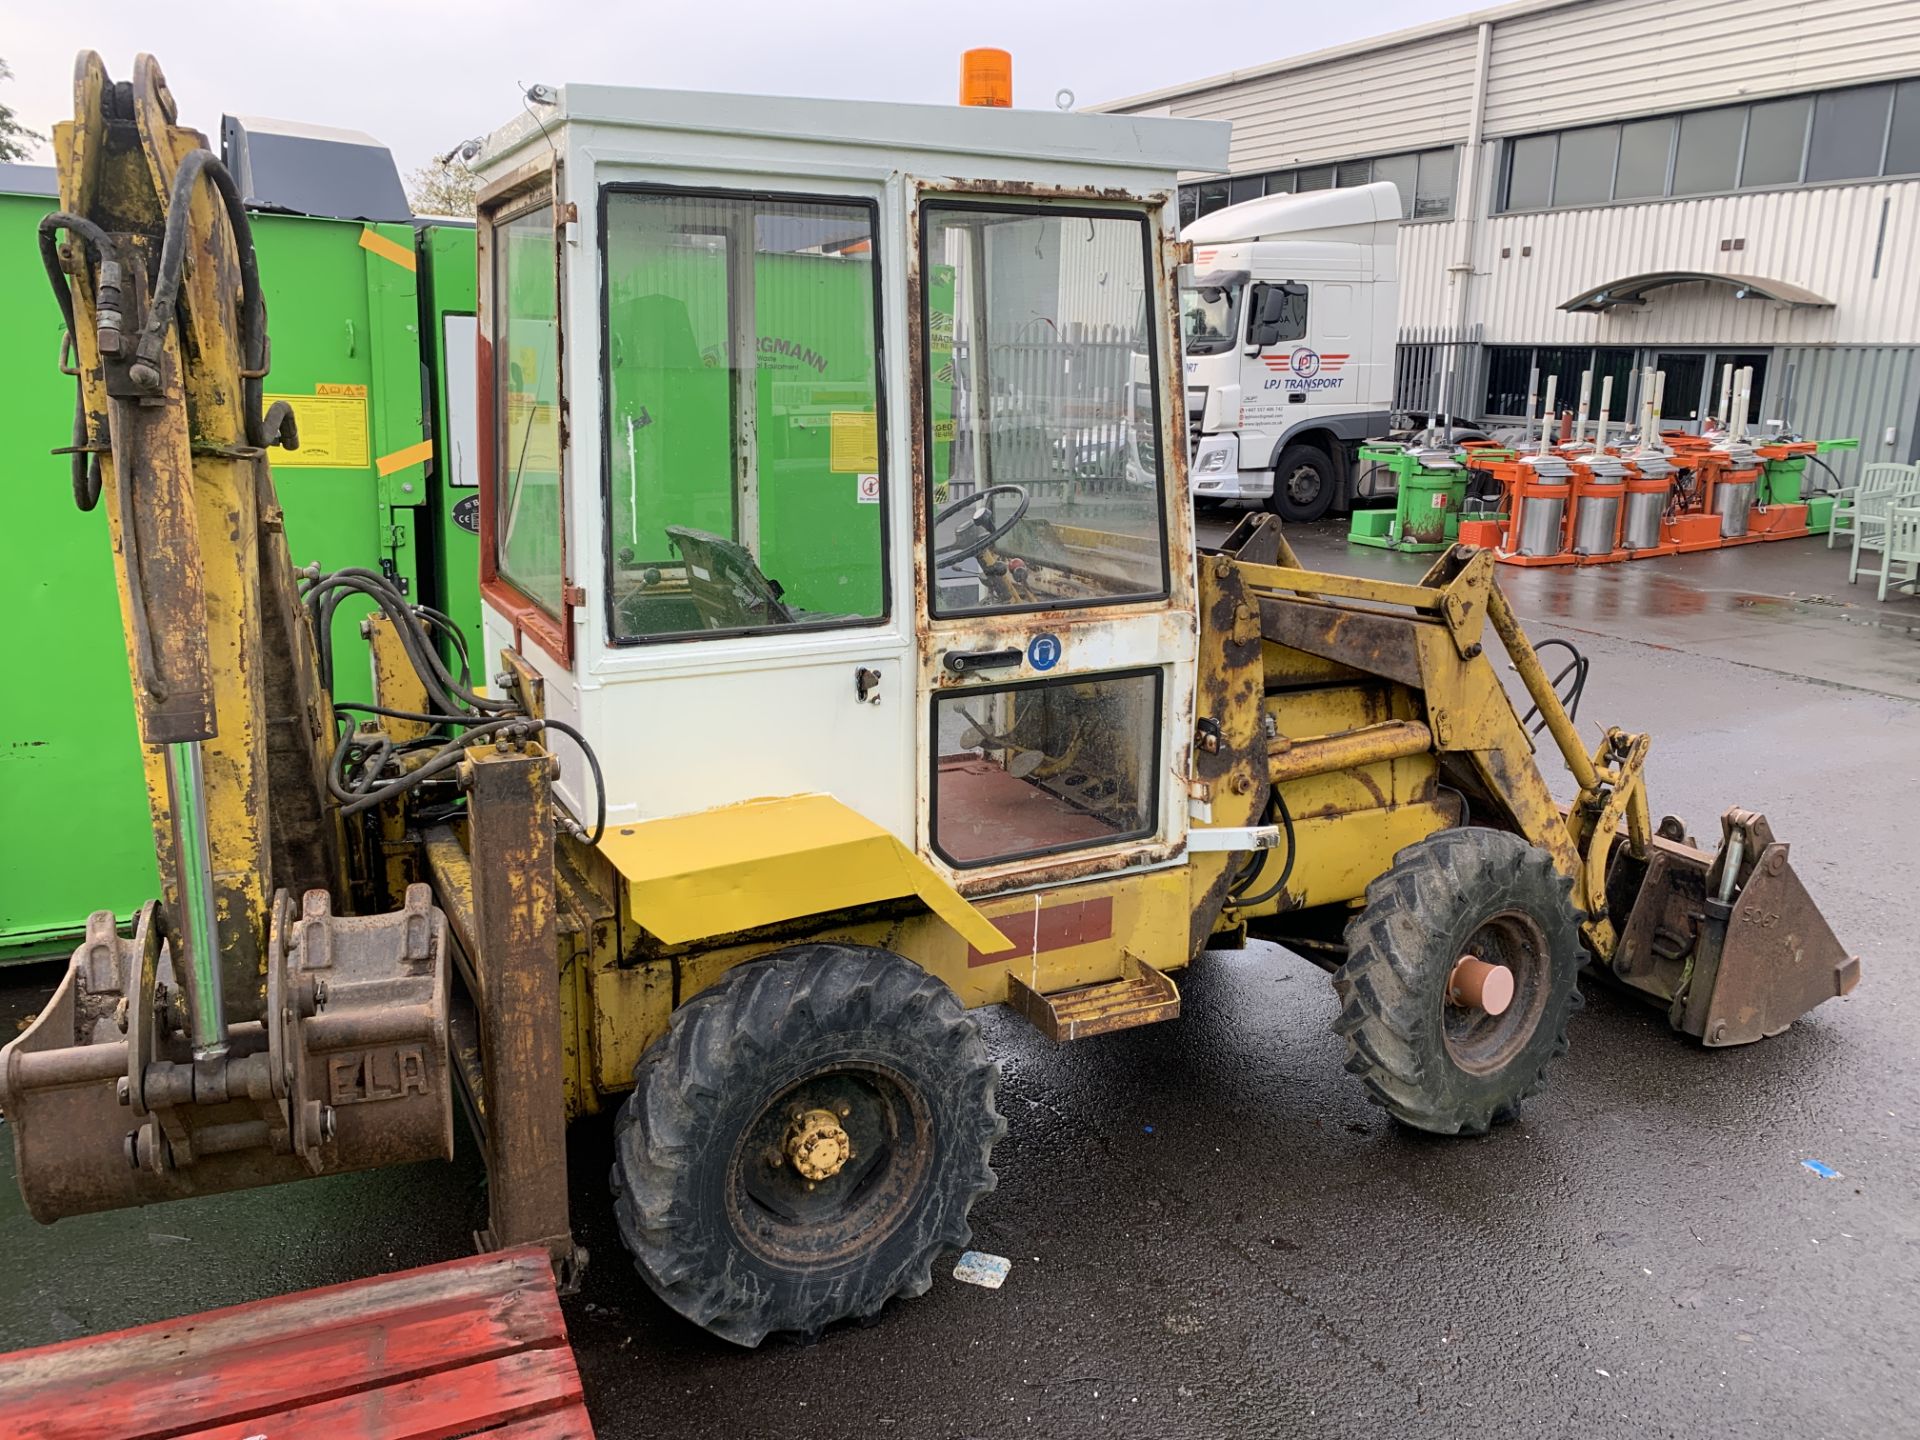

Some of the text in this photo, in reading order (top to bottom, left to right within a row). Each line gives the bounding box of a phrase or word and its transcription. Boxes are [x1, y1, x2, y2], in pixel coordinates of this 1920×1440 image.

[722, 336, 829, 374] RGMANN
[1264, 377, 1344, 390] LPJ TRANSPORT
